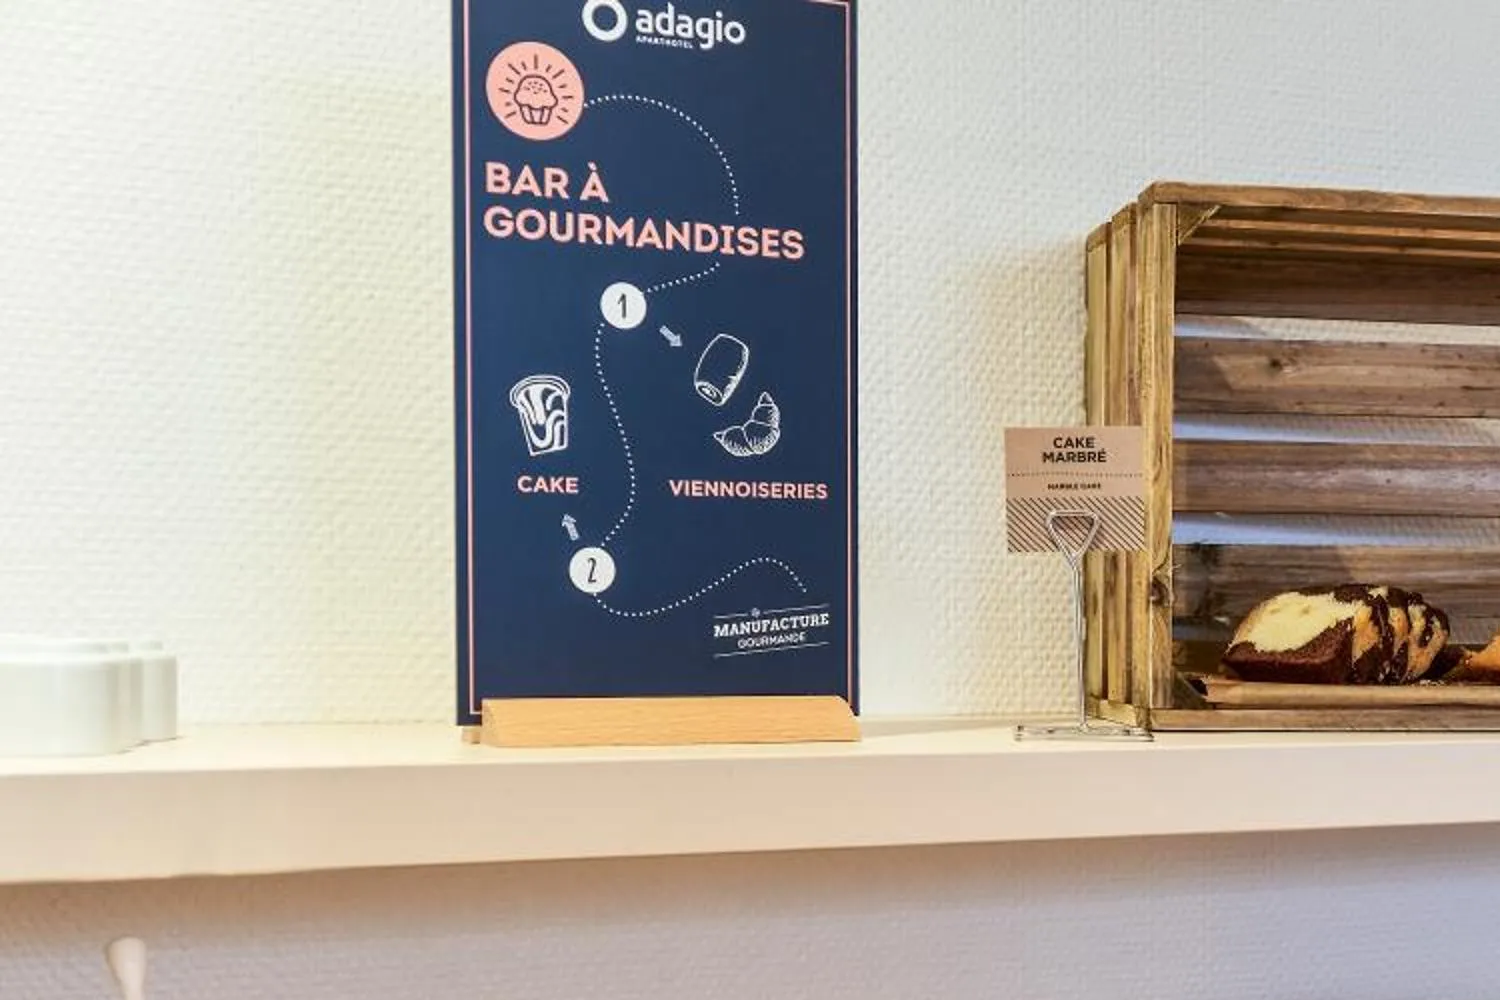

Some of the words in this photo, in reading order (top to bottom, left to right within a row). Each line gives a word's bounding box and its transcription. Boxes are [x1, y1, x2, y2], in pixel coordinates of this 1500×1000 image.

[636, 2, 746, 50] adagio
[485, 161, 570, 199] BAR
[580, 162, 610, 203] À
[484, 206, 805, 260] GOURMANDISES
[617, 293, 628, 319] 1
[1053, 437, 1095, 448] CAKE
[1042, 448, 1107, 463] MARBRÉ
[517, 475, 580, 495] CAKE
[669, 479, 829, 500] VIENNOISERIES
[587, 557, 598, 584] 2
[713, 613, 829, 637] MANUFACTURE
[737, 631, 806, 649] GOURMANDE
